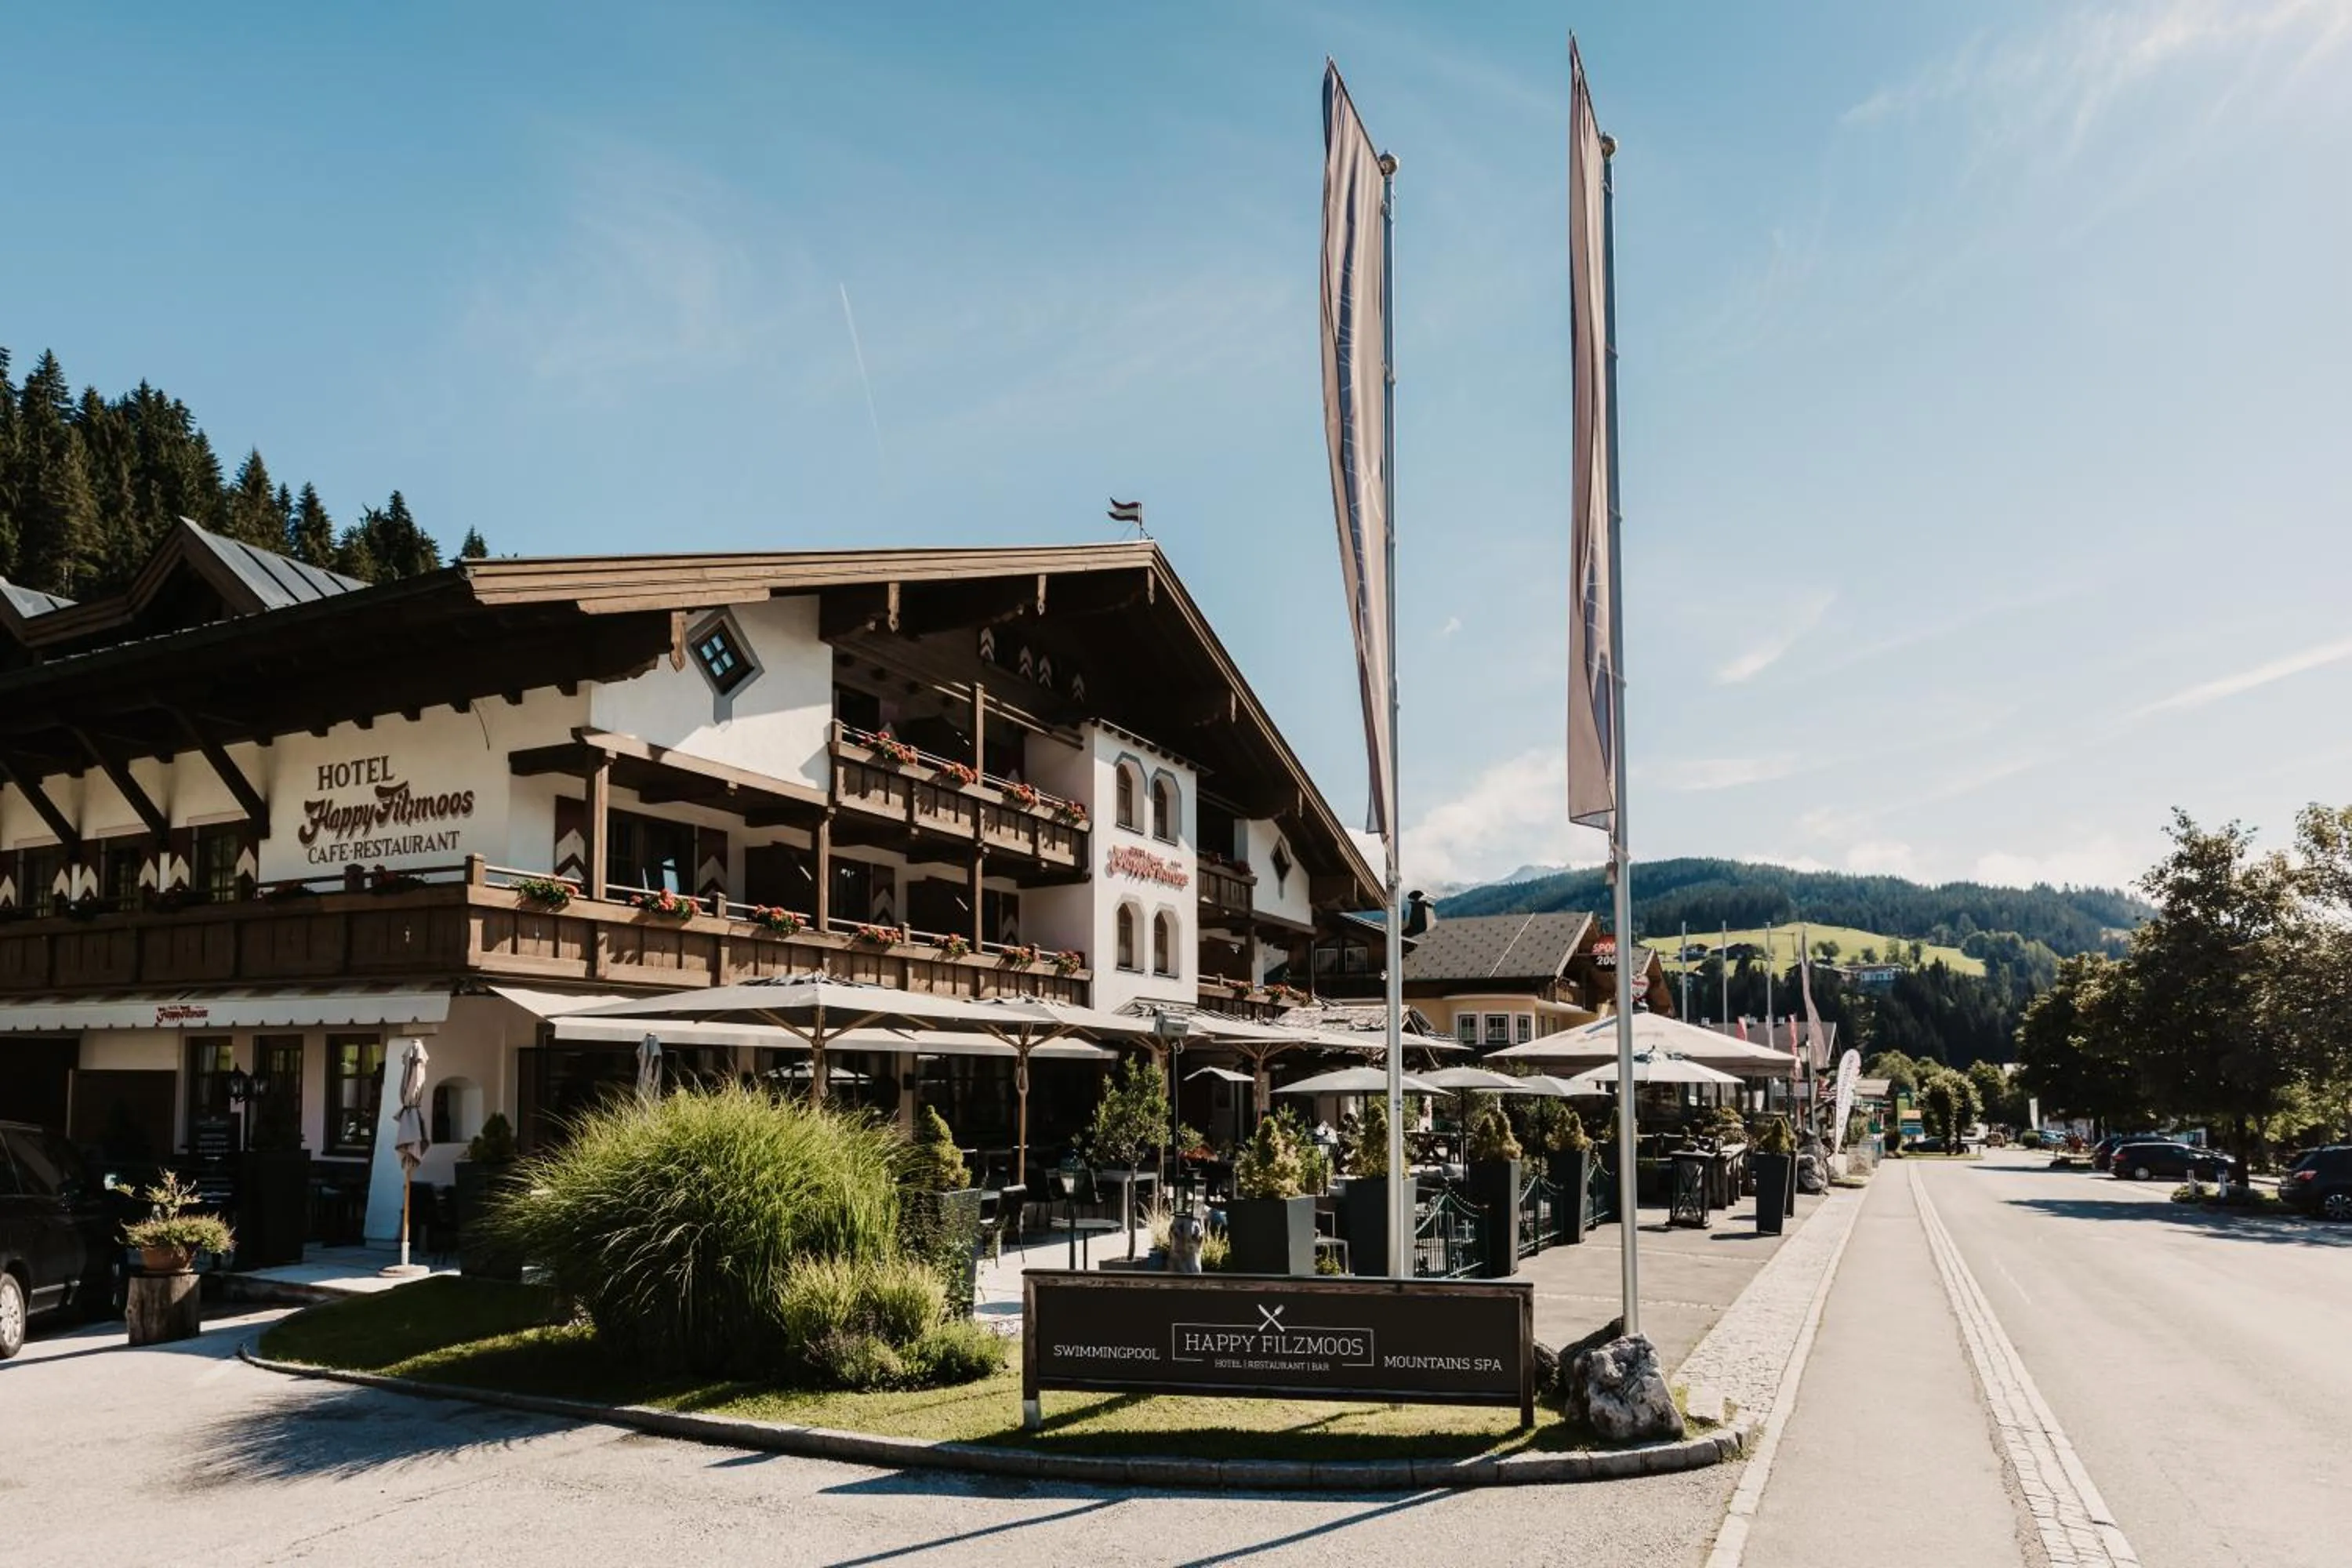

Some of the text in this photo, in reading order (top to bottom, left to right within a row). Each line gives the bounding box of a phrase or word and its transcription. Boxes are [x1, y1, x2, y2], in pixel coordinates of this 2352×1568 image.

[317, 755, 395, 791] HOTEL
[297, 780, 475, 848] Happy Filzmoos
[1592, 942, 1617, 954] SPO
[1596, 956, 1617, 966] 200
[1185, 1333, 1364, 1356] HAPPY FILZMOOS
[1053, 1345, 1160, 1360] SWIMMINGPOOL
[1384, 1356, 1503, 1371] MOUNTAINS SPA
